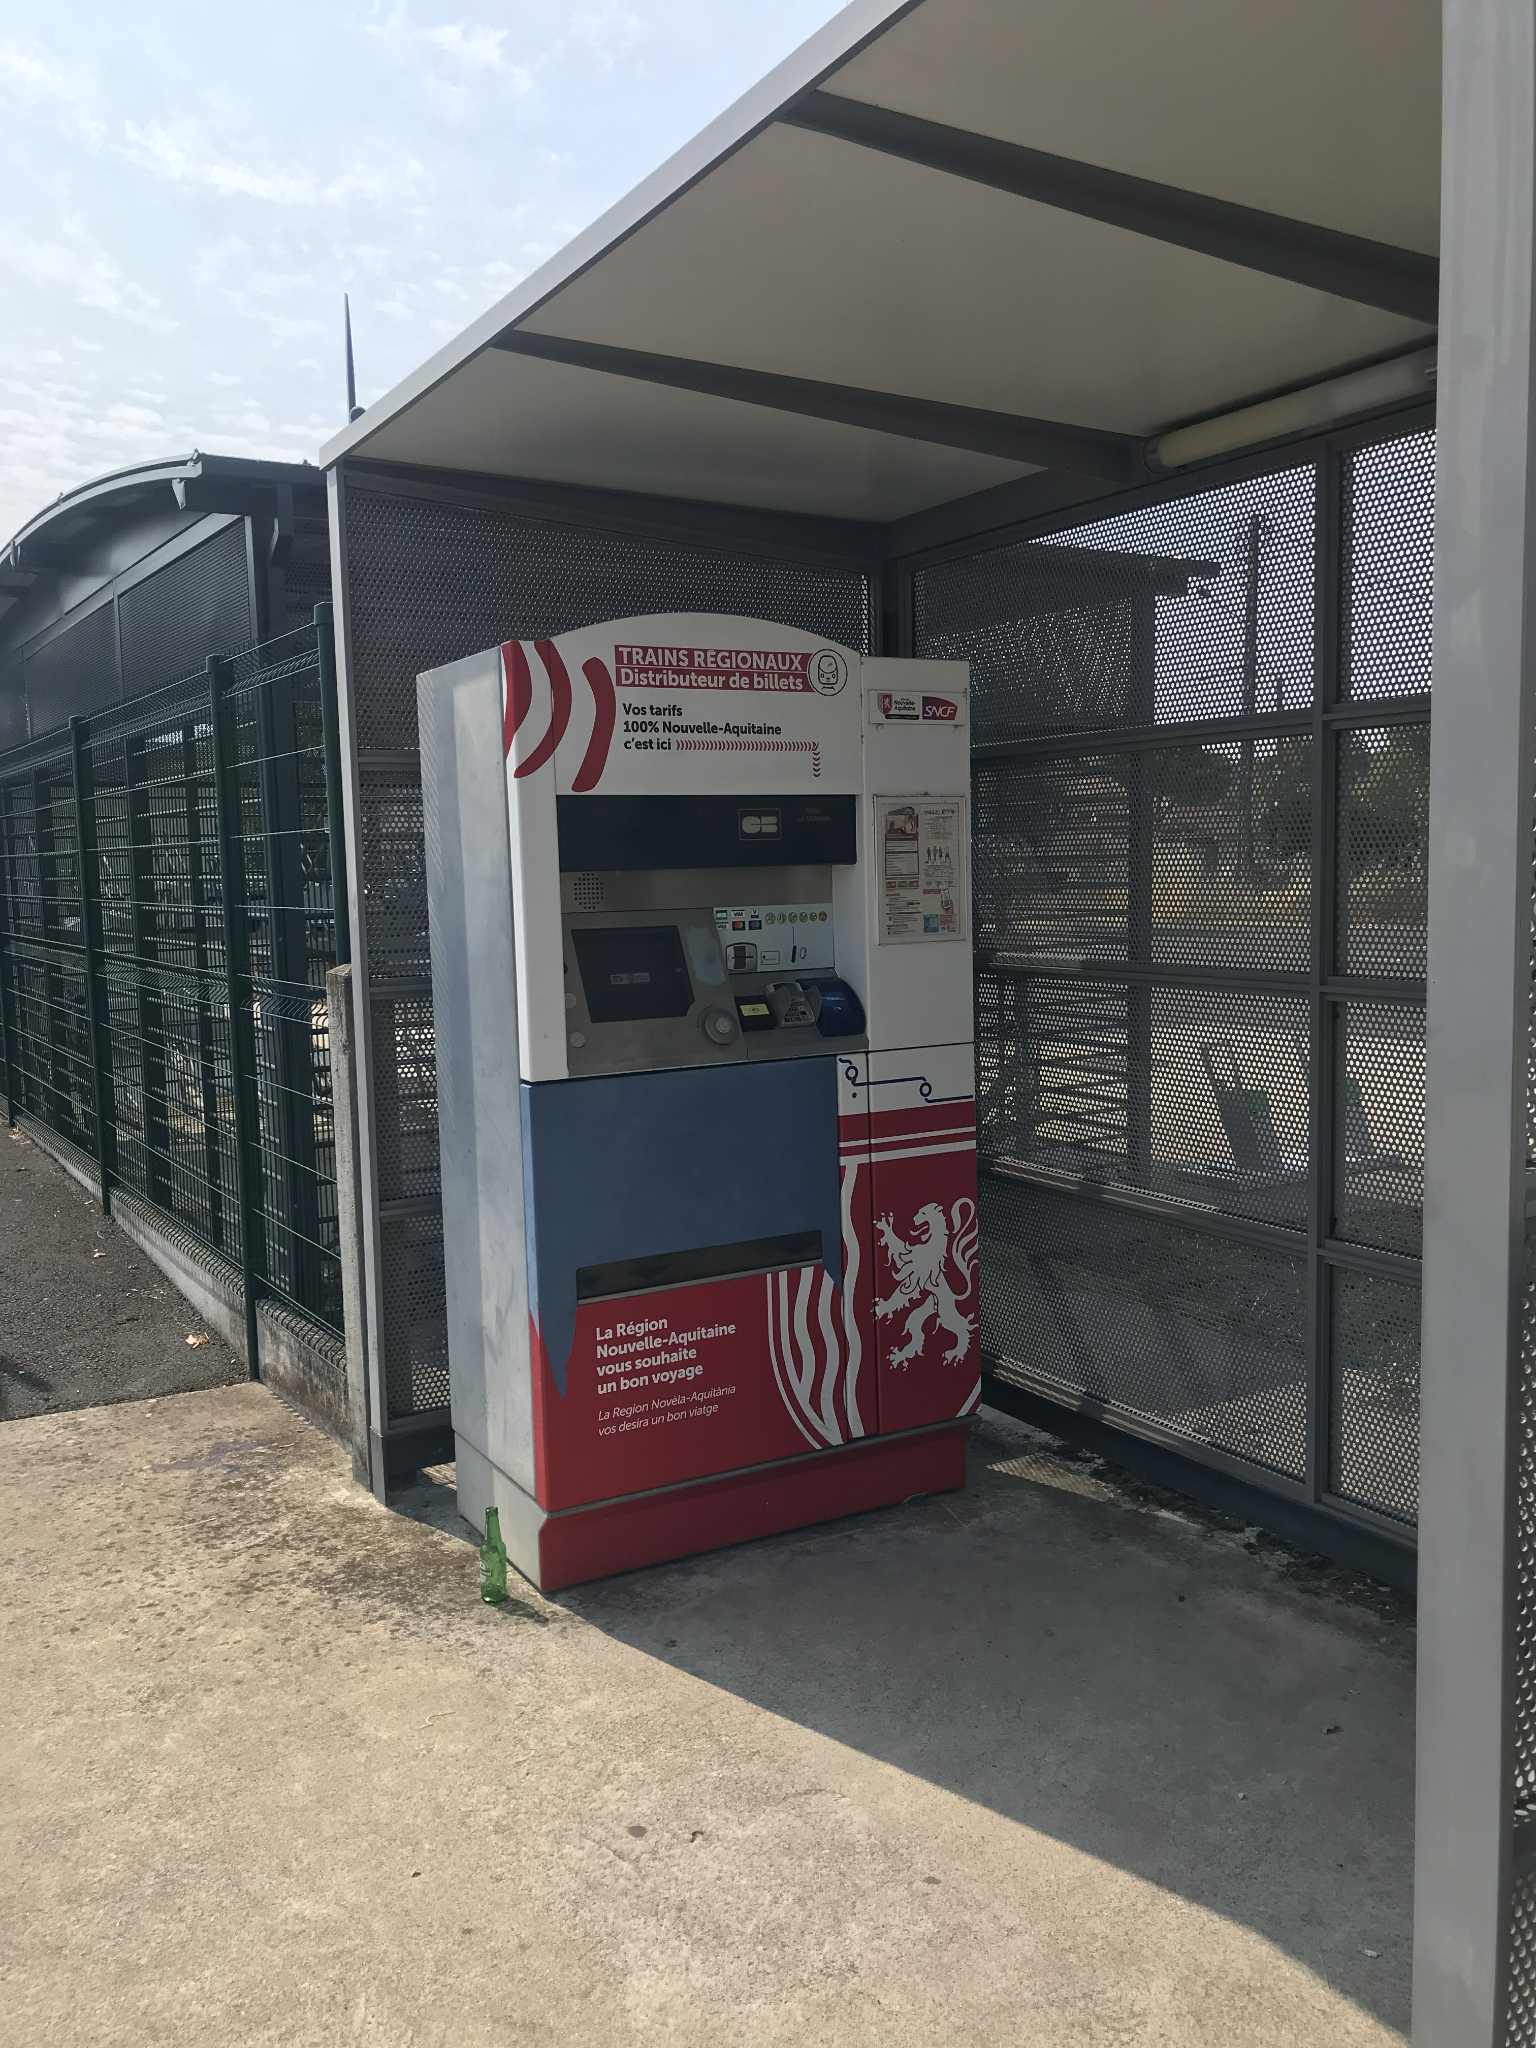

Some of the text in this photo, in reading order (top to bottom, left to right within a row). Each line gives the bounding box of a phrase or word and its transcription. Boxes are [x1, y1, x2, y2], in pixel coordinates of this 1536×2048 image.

[618, 647, 689, 667] TRAINS
[621, 669, 803, 690] Distributeur de billets
[623, 703, 683, 717] Vos tarifs
[924, 705, 956, 717] SNCF
[623, 721, 782, 737] 100% Nouvelle-Aquitaine
[624, 738, 672, 750] c'est ici
[596, 1318, 668, 1340] La Région
[596, 1323, 737, 1358] Nouvelle-Aquitaine
[596, 1348, 697, 1376] vous souhaite
[597, 1364, 704, 1394] un bon voyage
[598, 1410, 610, 1421] La
[612, 1402, 649, 1418] Region
[598, 1403, 719, 1436] vos desira un bon viatge
